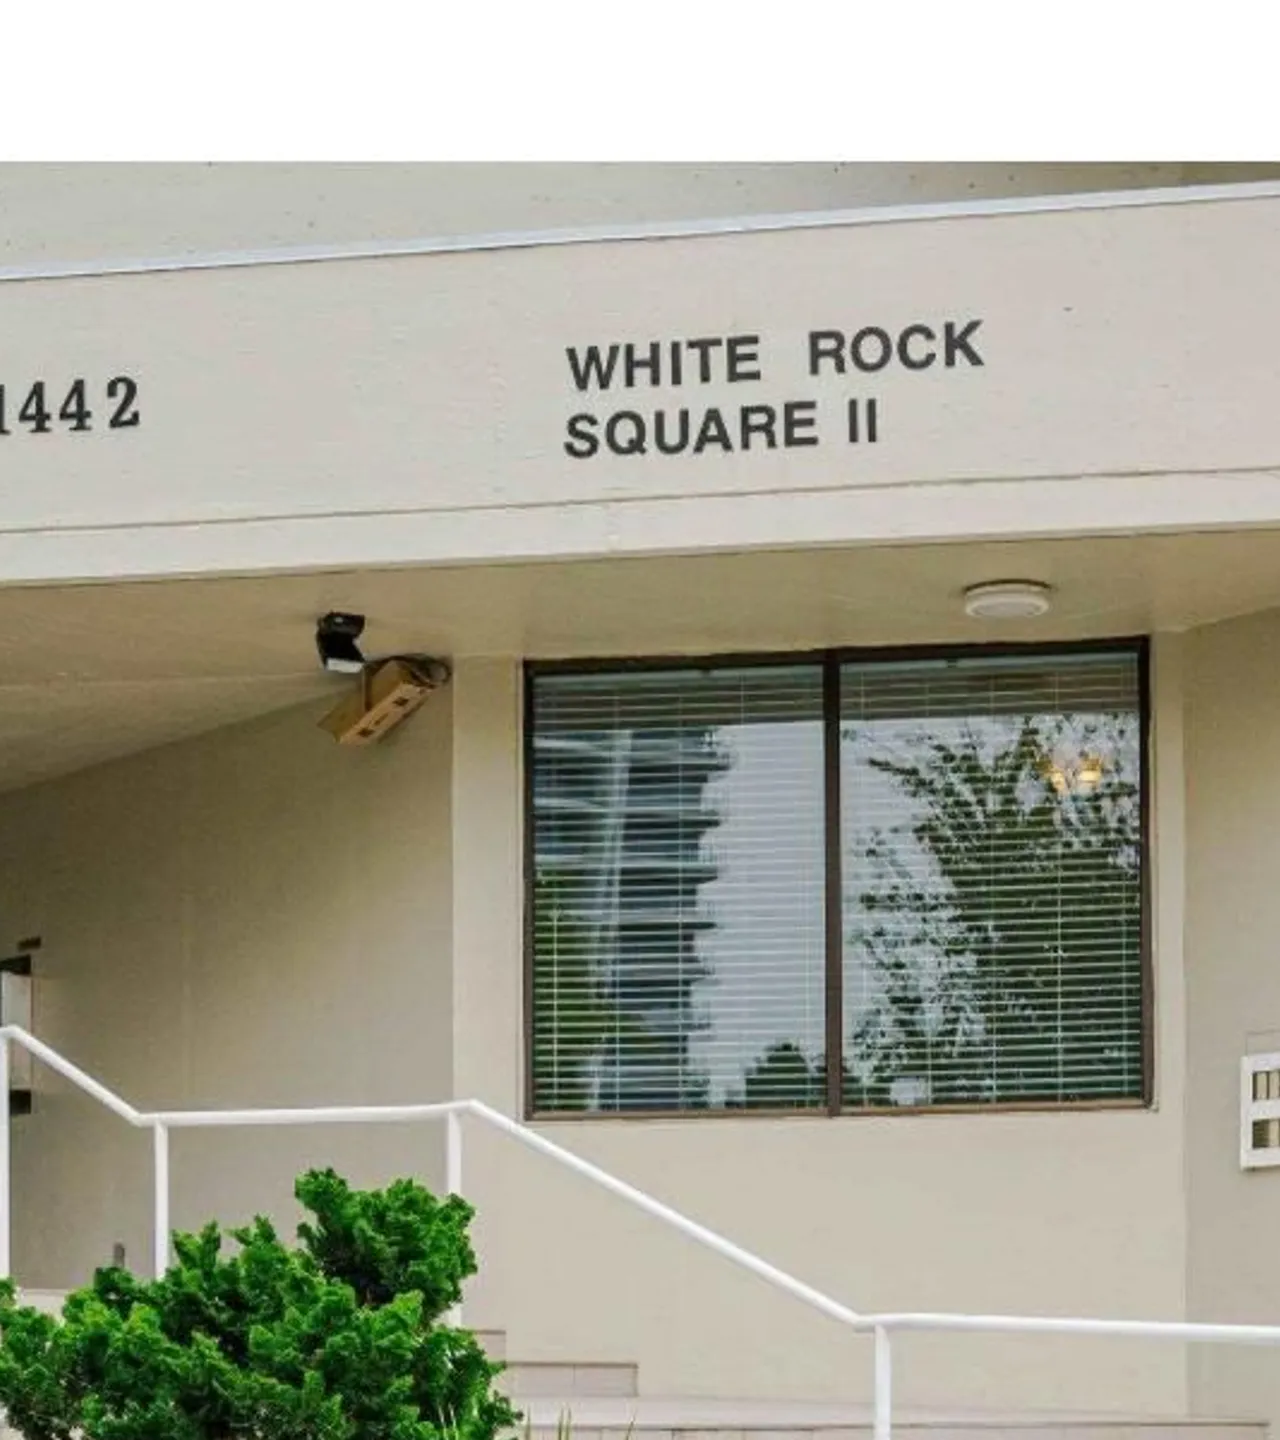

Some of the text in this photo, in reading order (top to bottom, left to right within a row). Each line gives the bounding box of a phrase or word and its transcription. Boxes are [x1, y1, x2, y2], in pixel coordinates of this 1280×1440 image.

[565, 319, 986, 392] WHITE ROCK
[563, 398, 877, 459] SQUARE II
